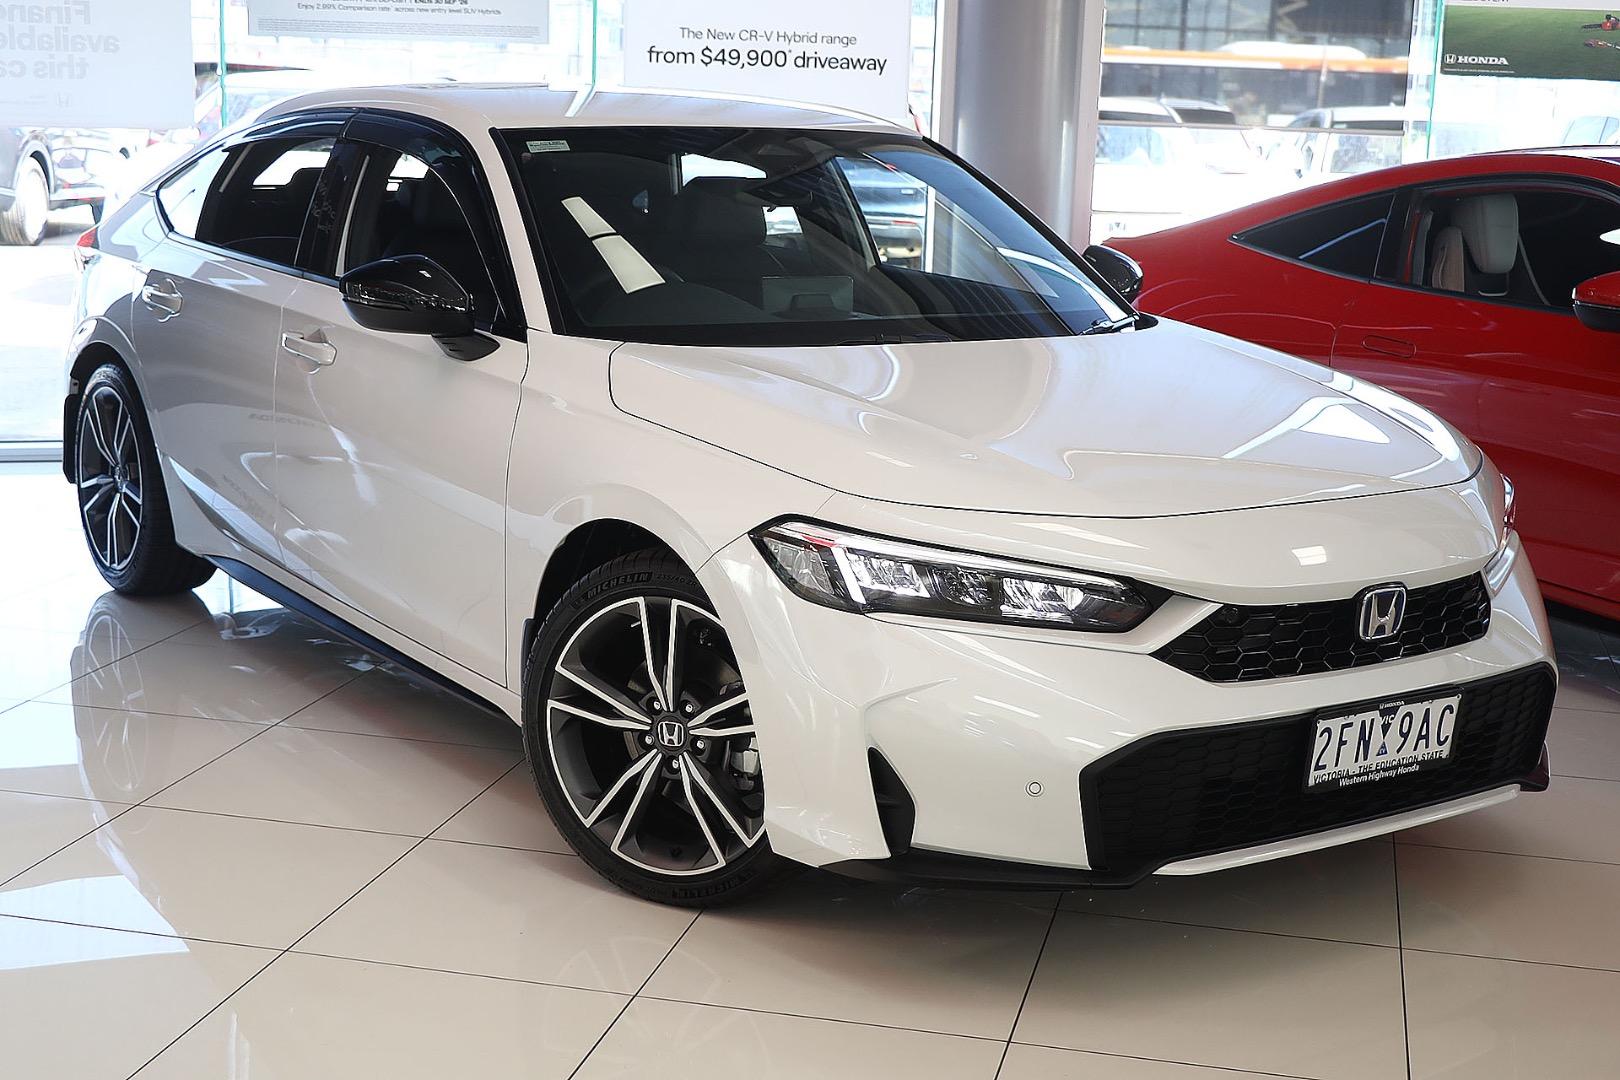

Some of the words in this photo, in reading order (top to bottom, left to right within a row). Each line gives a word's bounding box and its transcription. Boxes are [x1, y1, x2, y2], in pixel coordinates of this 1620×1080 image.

[680, 26, 703, 40] The
[706, 28, 736, 41] New
[738, 29, 774, 42] CR-V
[776, 31, 818, 45] Hybrid
[821, 34, 857, 47] range
[647, 46, 696, 65] from
[793, 51, 888, 76] driveaway
[1457, 56, 1509, 65] HONDA
[587, 572, 649, 599] MICHELIN
[1381, 714, 1395, 724] VIC
[1314, 717, 1375, 772] 2FN
[1396, 704, 1455, 755] 9AC
[1314, 768, 1350, 784] VICTORIA
[1358, 763, 1374, 774] THE
[1375, 754, 1419, 770] EDUCATION
[1421, 749, 1444, 761] STATE
[1339, 775, 1368, 787] Western
[1368, 769, 1397, 782] Highway
[1397, 764, 1420, 775] Honda
